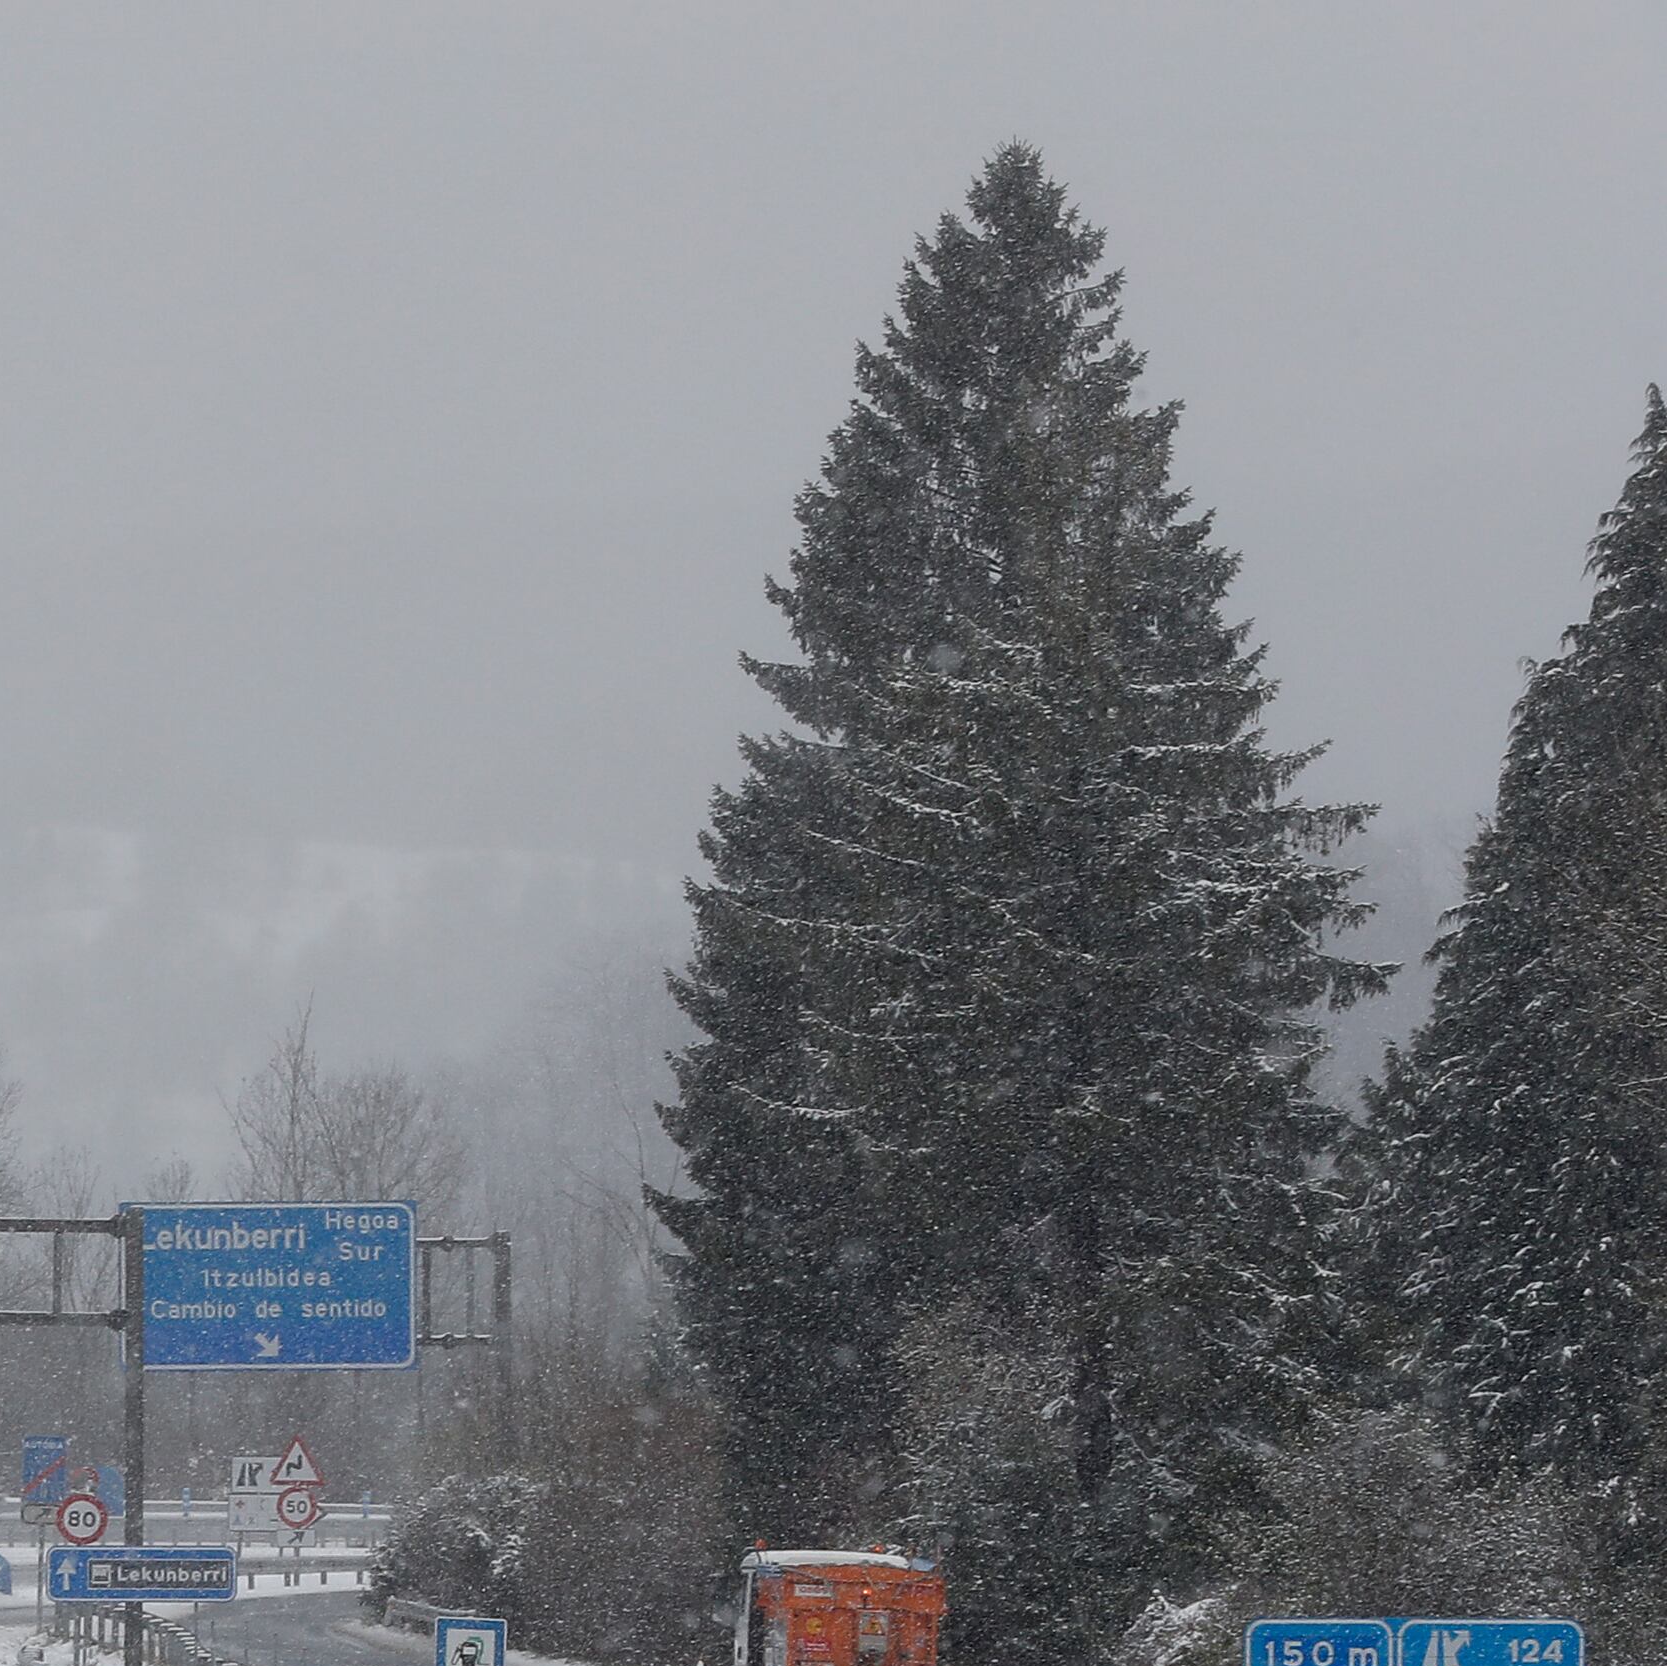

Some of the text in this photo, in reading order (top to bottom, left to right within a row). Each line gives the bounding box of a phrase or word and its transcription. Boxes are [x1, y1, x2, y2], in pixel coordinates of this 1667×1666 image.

[324, 1210, 400, 1234] Hegoa
[337, 1242, 385, 1261] Sur
[150, 1299, 387, 1319] Cambio de sentido
[286, 1500, 307, 1514] 50
[67, 1510, 97, 1528] 80
[116, 1566, 228, 1583] Lekunberri
[1507, 1638, 1564, 1665] 124
